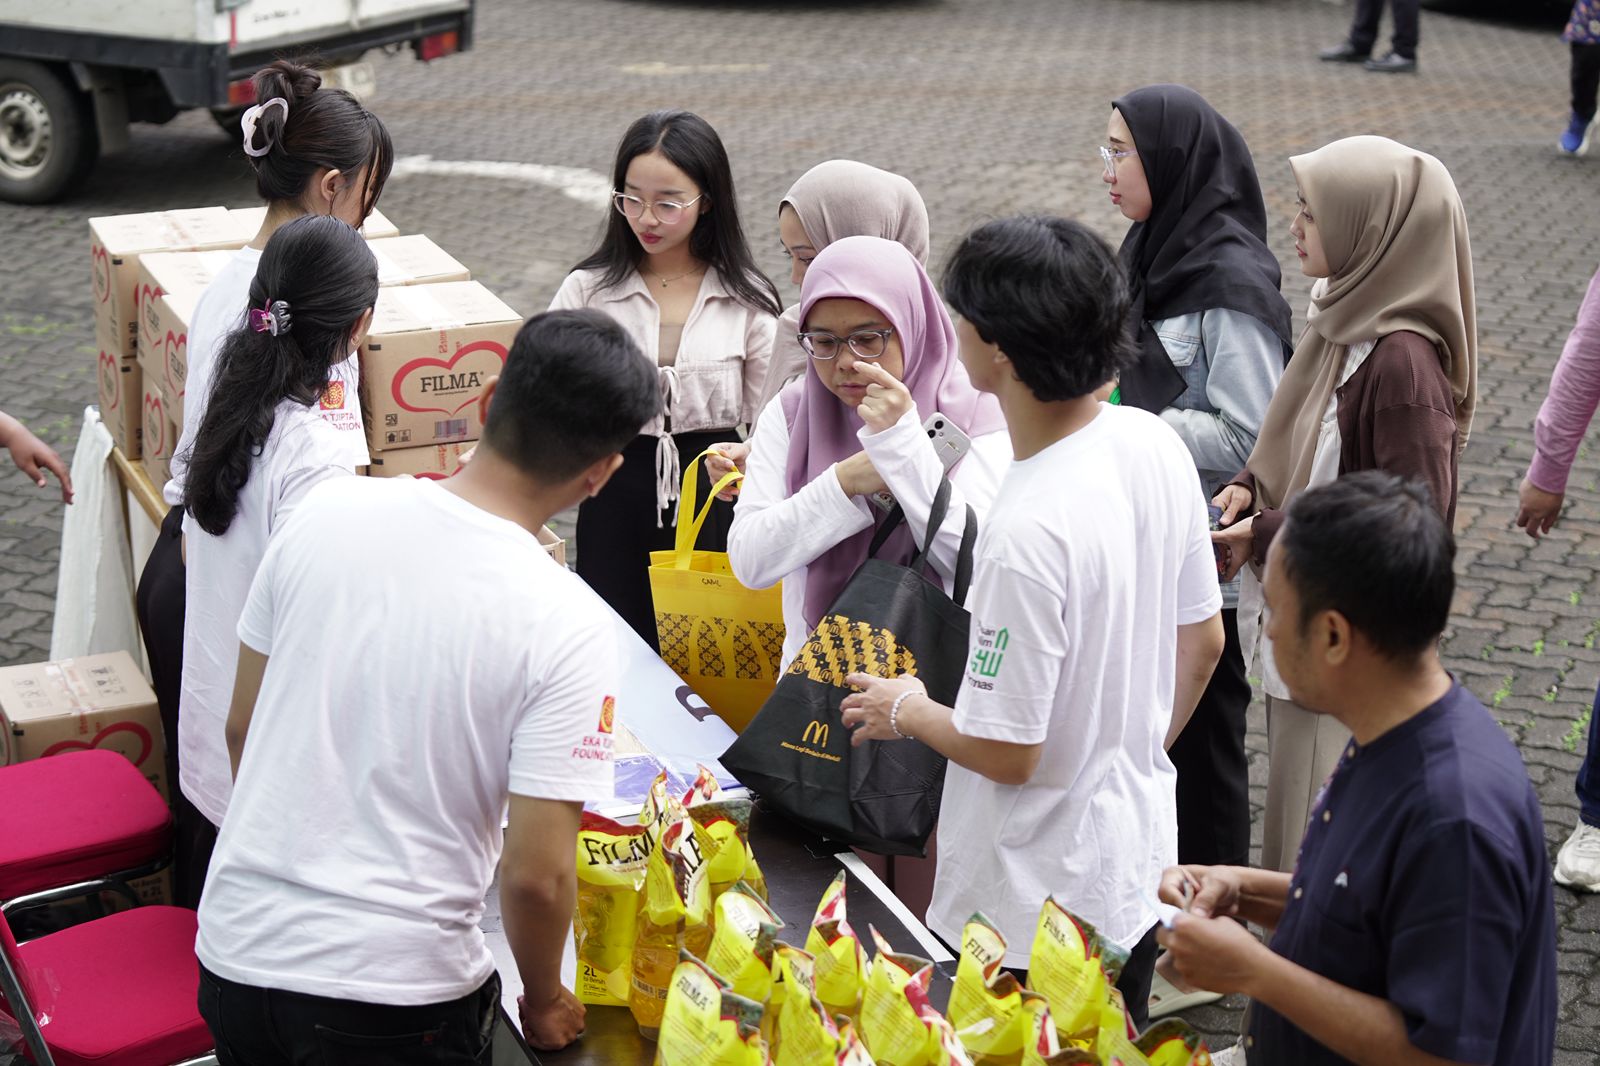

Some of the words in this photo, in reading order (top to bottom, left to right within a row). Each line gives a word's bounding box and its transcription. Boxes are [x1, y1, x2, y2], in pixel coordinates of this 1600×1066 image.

[420, 371, 481, 393] FILMA
[582, 827, 656, 866] FILM
[676, 975, 708, 1011] FILMA
